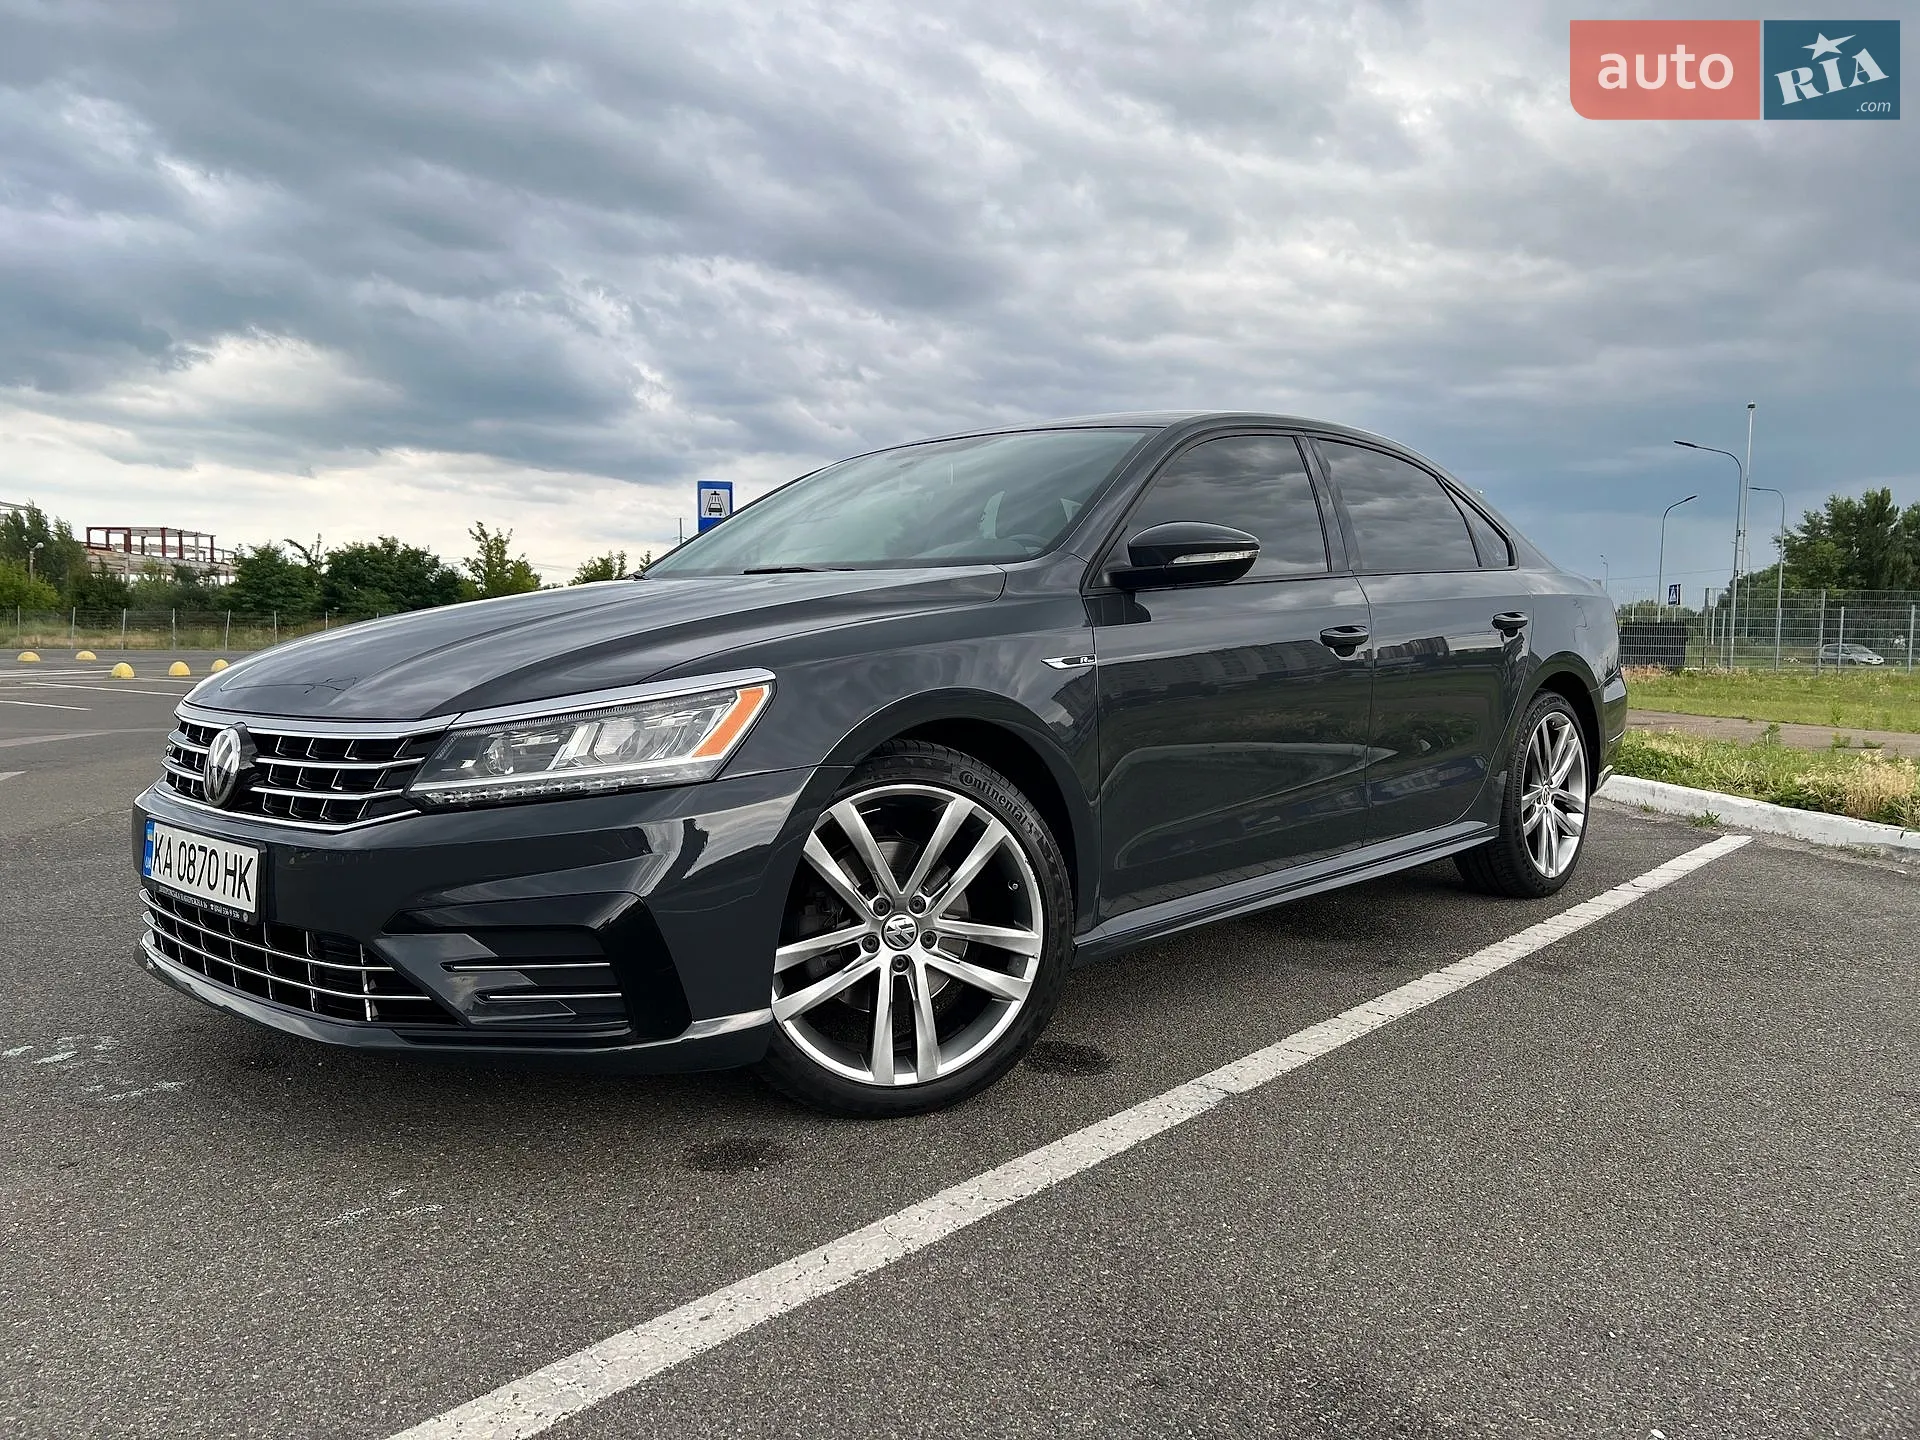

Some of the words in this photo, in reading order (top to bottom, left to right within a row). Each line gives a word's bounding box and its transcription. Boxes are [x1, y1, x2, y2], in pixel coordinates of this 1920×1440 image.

[959, 770, 1029, 826] Continental
[153, 832, 173, 878] KA
[177, 841, 220, 891] 0870
[222, 851, 254, 903] HK
